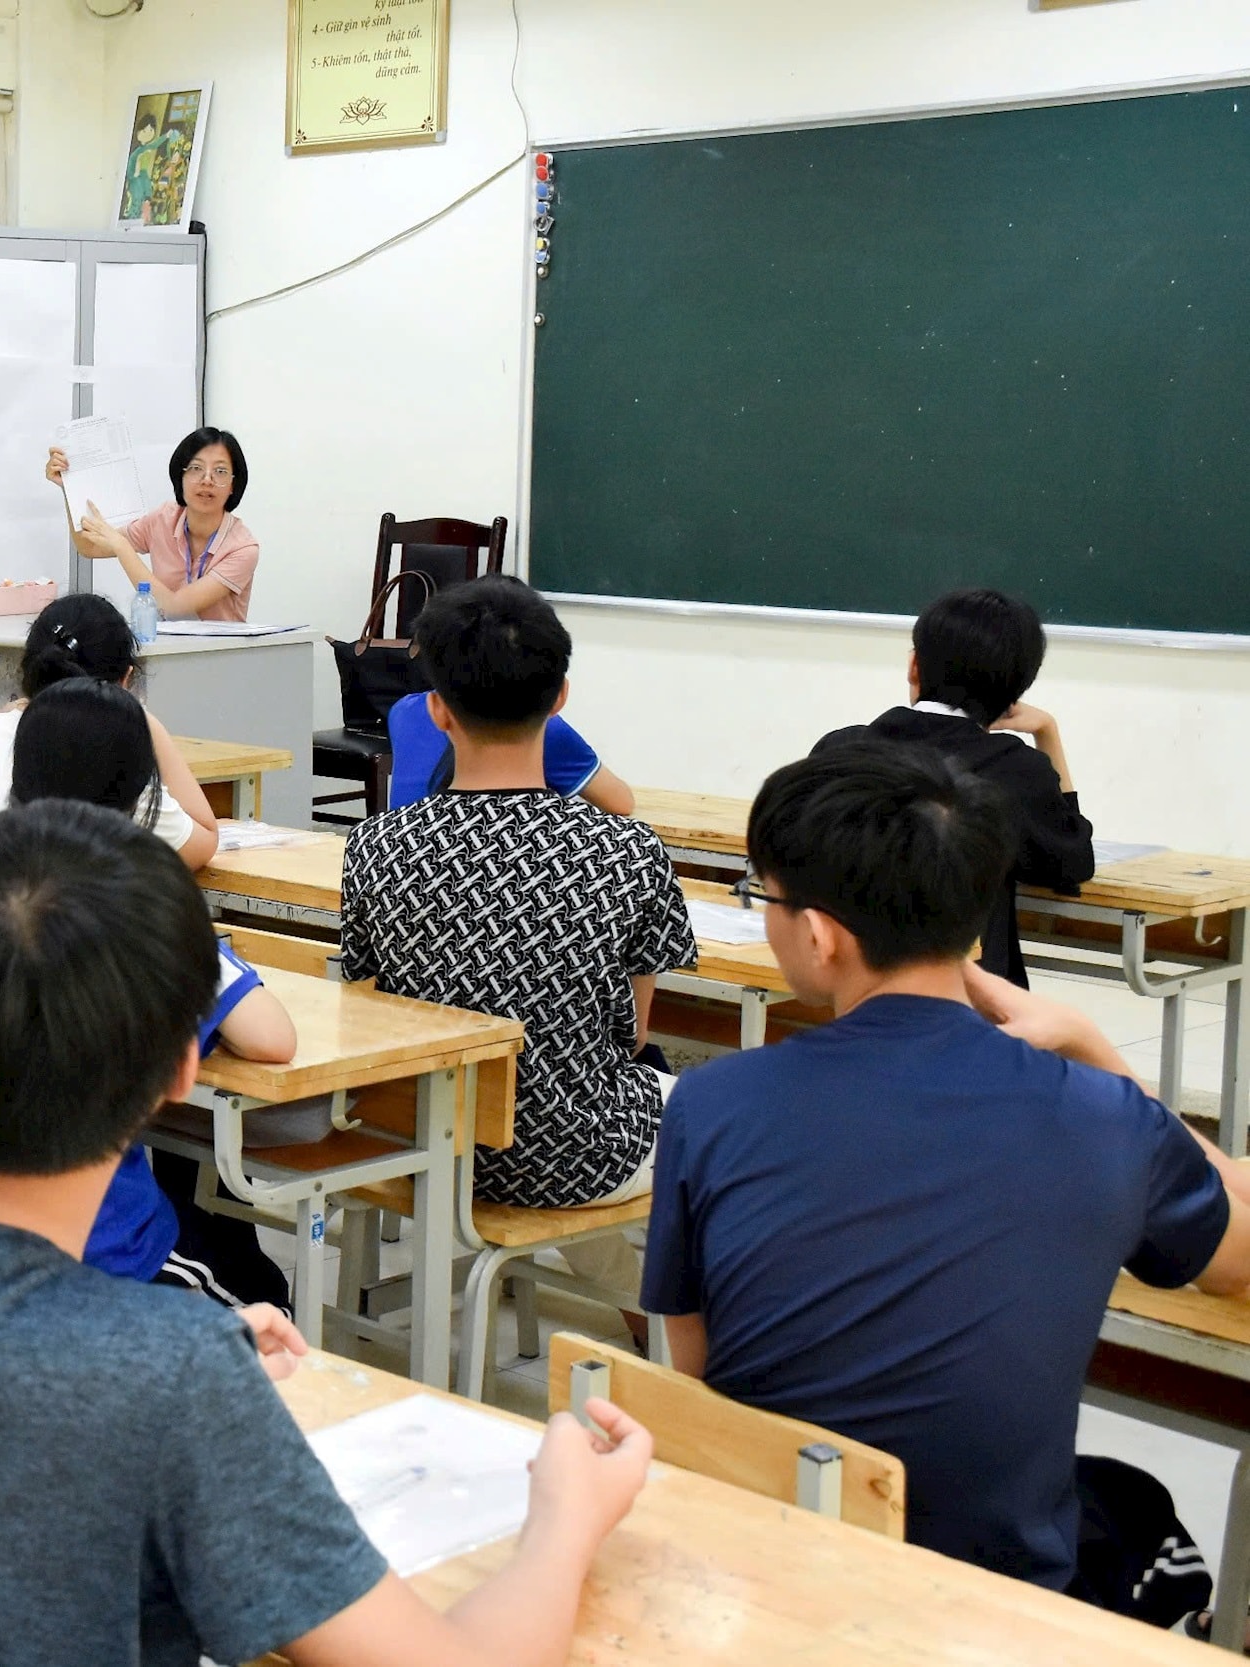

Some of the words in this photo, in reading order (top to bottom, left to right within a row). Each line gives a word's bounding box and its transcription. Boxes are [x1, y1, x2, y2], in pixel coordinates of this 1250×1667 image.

[361, 16, 371, 30] vệ
[371, 13, 391, 27] sinh
[386, 28, 405, 43] thật
[407, 24, 423, 39] tốt.
[354, 49, 370, 63] tốn,
[373, 49, 391, 62] thật
[375, 66, 398, 79] dũng
[400, 62, 421, 75] cảm.
